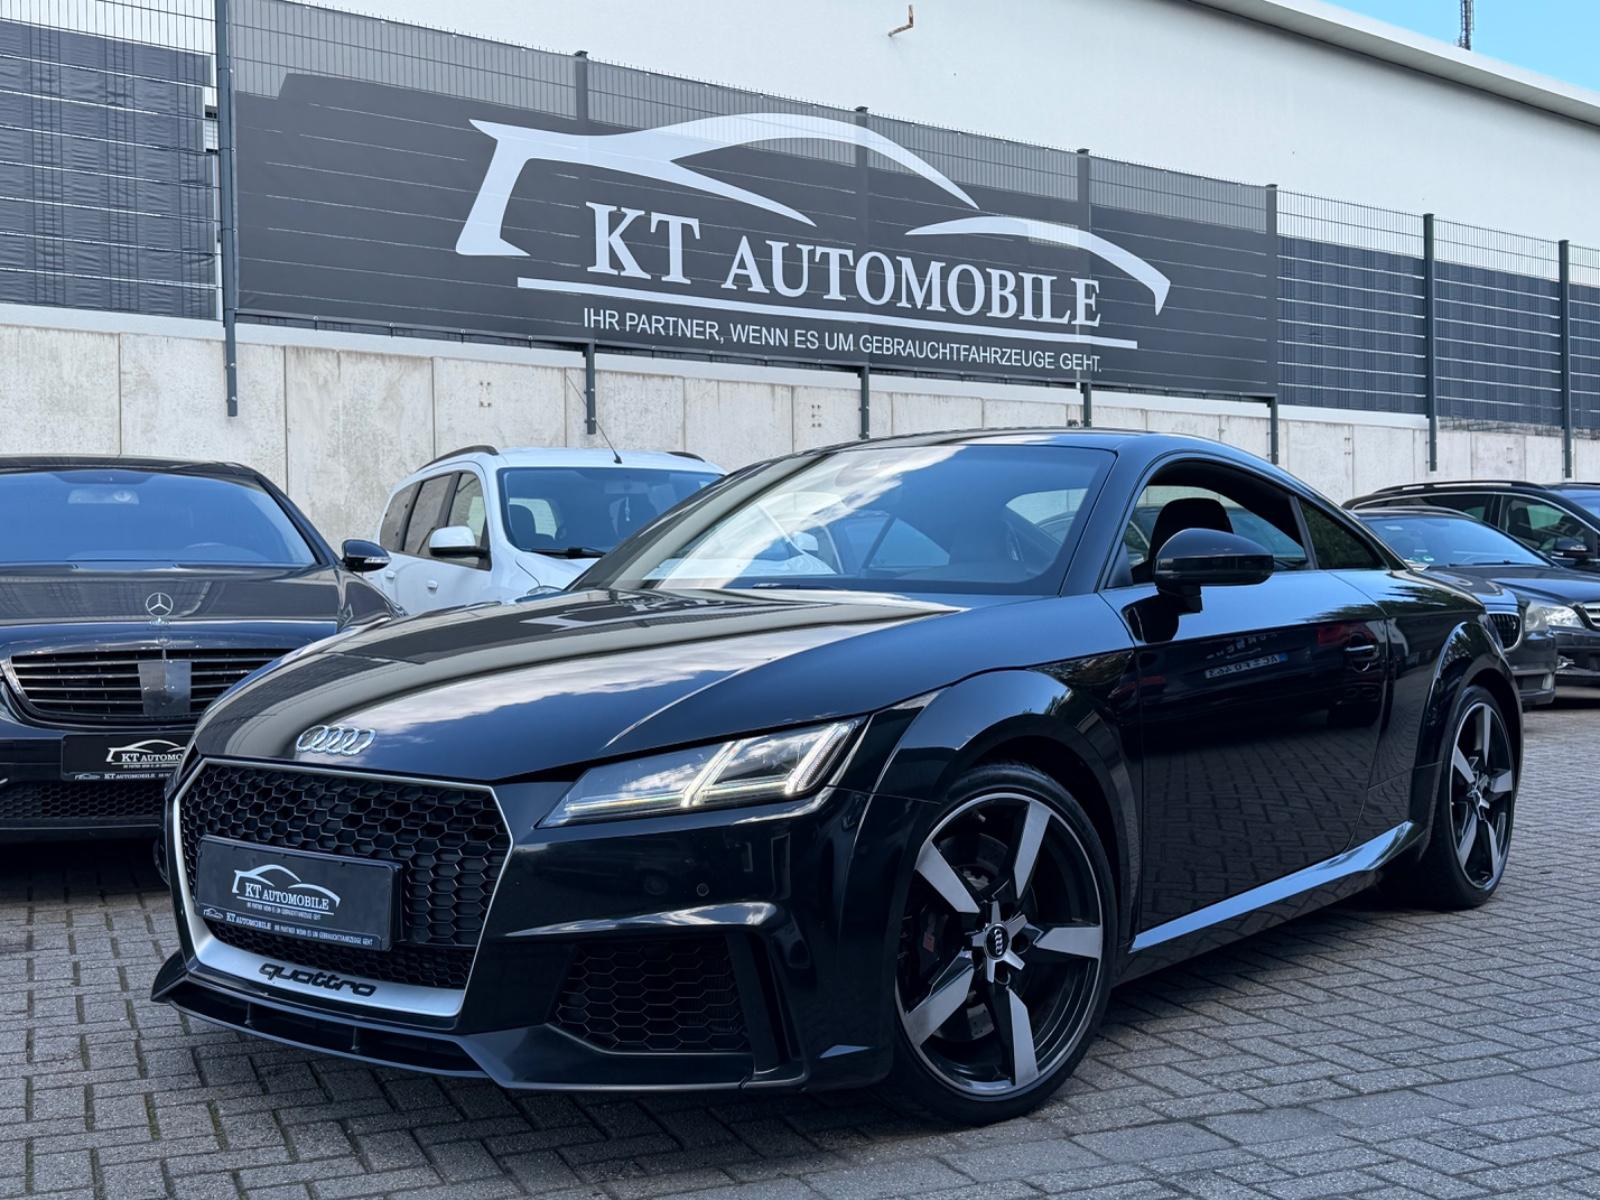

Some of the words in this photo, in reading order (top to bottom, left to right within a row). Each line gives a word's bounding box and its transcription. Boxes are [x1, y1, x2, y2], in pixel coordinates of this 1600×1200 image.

[585, 201, 701, 285] KT
[721, 235, 1102, 327] AUTOMOBILE
[583, 307, 620, 331] IHR
[625, 312, 725, 345] PARTNER,
[730, 323, 789, 348] WENN
[794, 329, 819, 350] ES
[825, 332, 854, 352] UM
[859, 334, 1056, 370] GEBRAUCHTFAHRZEUGE
[1059, 352, 1102, 373] GEHT.
[121, 753, 140, 763] KT
[141, 754, 183, 762] AUTOMO
[245, 882, 262, 899] KT
[262, 891, 330, 911] AUTOMOBILE
[259, 963, 377, 997] quattro
